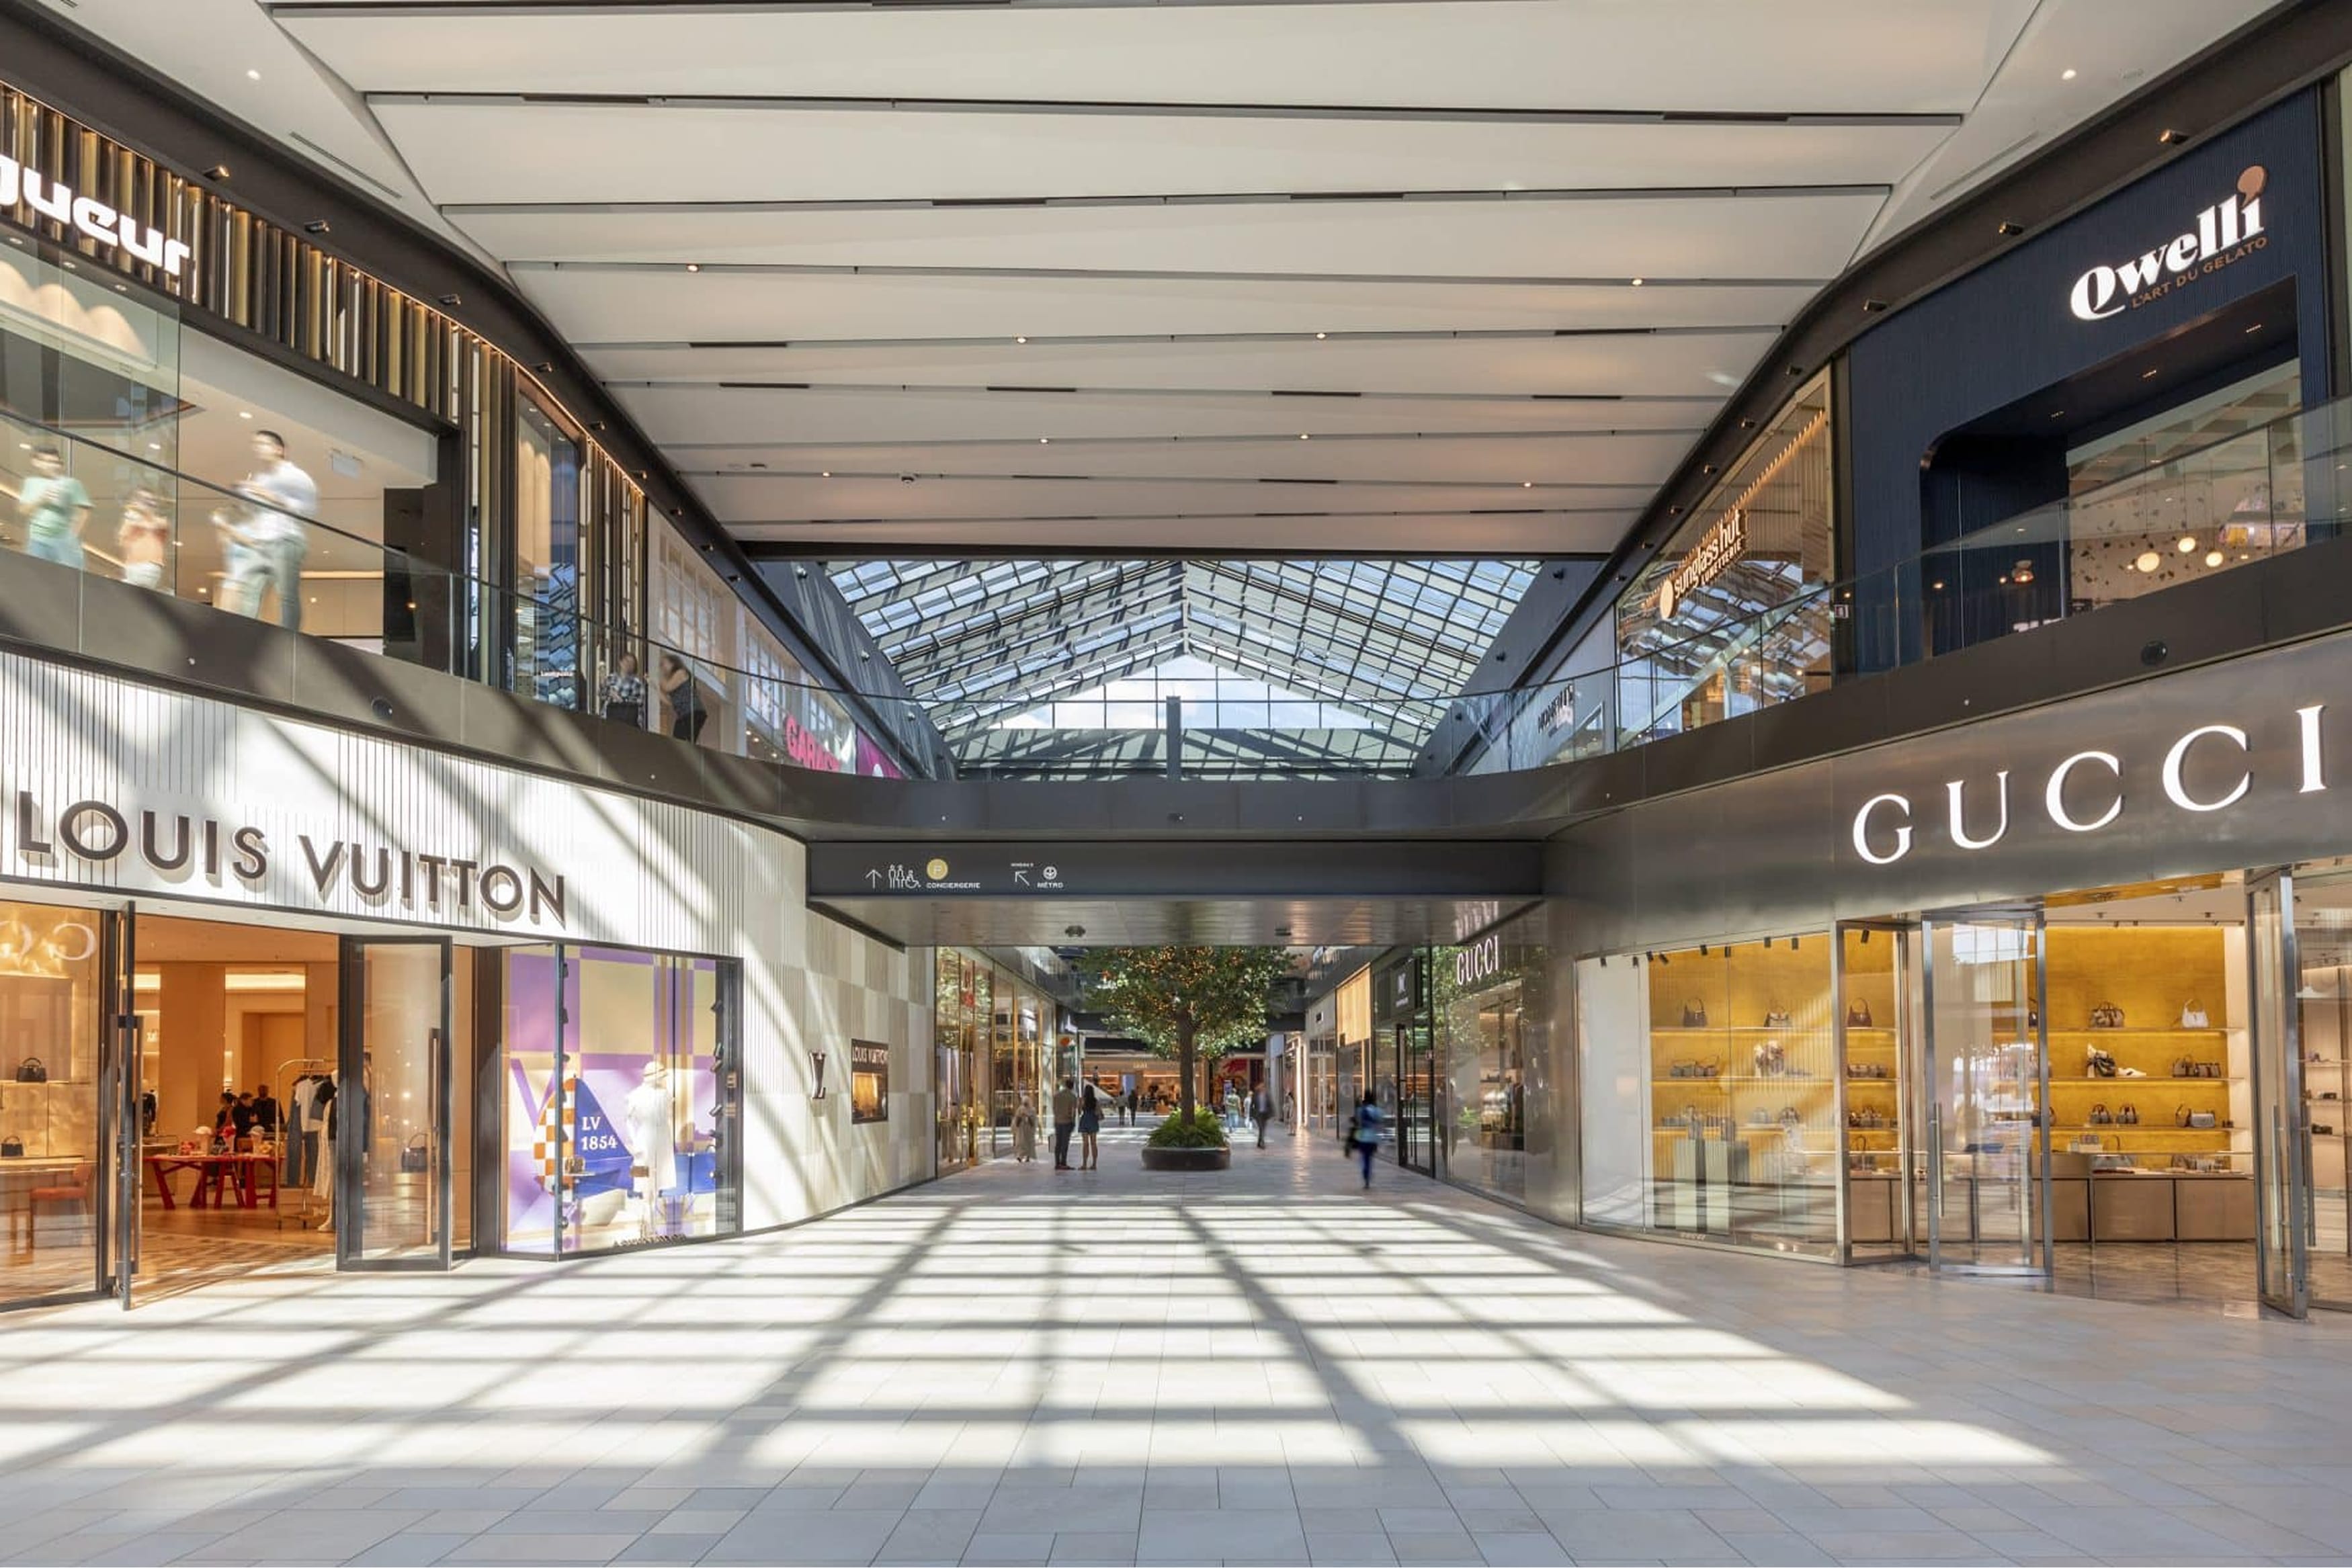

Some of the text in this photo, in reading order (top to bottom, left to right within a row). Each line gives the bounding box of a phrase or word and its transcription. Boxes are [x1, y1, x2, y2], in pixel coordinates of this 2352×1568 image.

[2070, 165, 2267, 320] Qwelli
[2132, 236, 2268, 309] L'ART DU GELATO
[1674, 509, 1741, 600] sunglass hut
[1853, 704, 2327, 864] GUCCI
[17, 791, 566, 930] LOUIS VUITTON
[1457, 934, 1499, 986] GUCCI
[581, 1135, 618, 1150] 1854
[582, 1116, 601, 1131] LV
